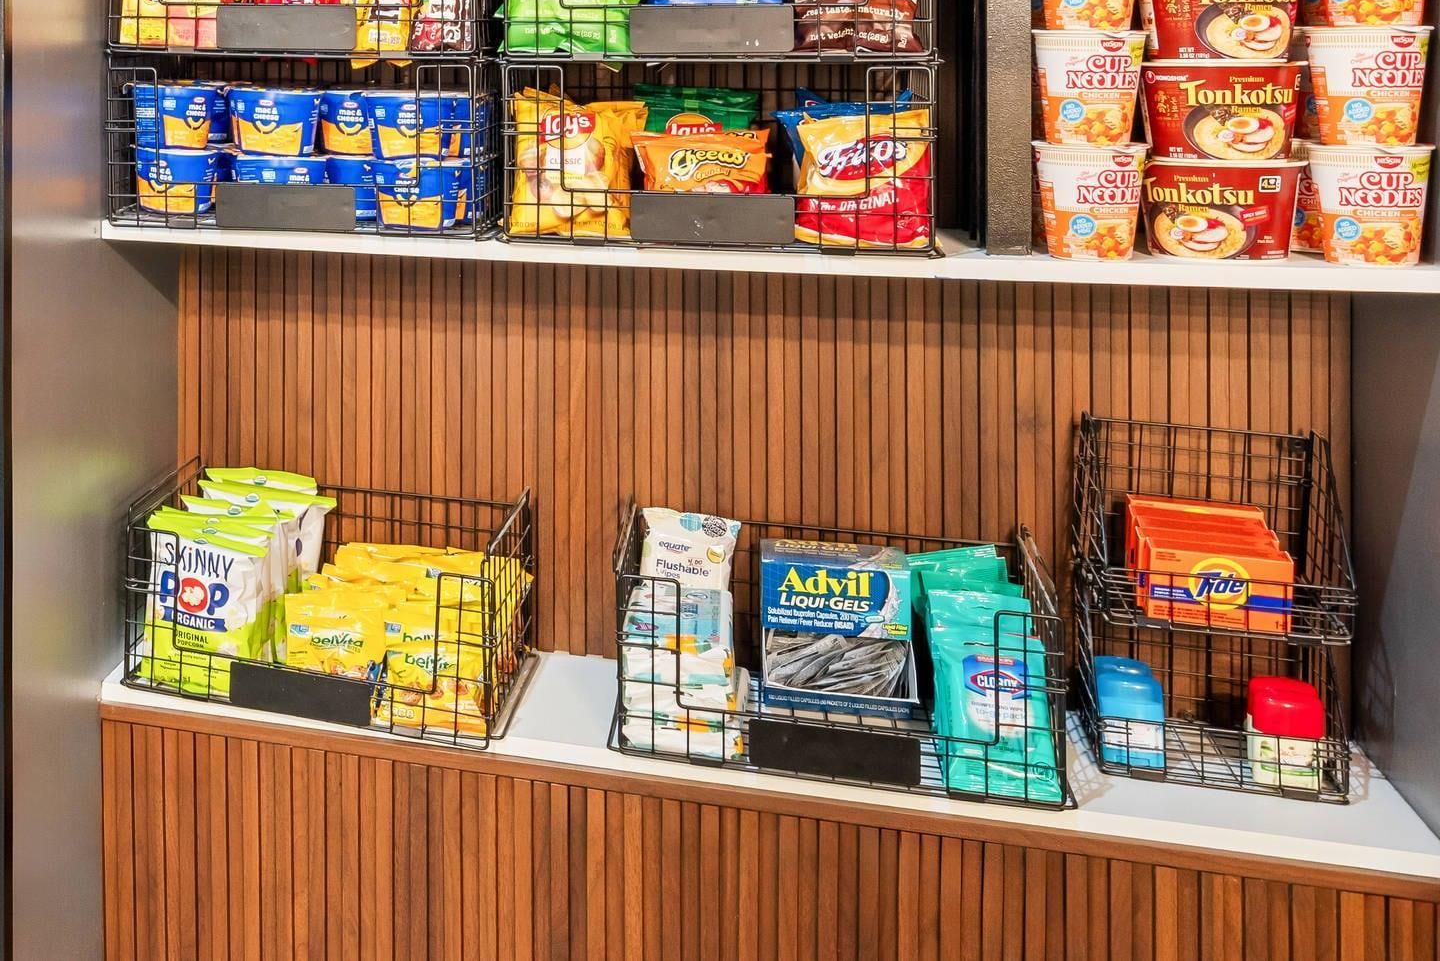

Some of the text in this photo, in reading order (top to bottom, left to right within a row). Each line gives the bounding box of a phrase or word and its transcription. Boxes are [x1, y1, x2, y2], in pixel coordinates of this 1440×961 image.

[1244, 3, 1273, 12] Ramen
[1086, 55, 1132, 73] CUP
[1375, 51, 1423, 70] CUP
[1066, 70, 1138, 89] NOODLES
[1179, 79, 1293, 106] Tonkotsu
[1231, 105, 1261, 114] Ramen
[337, 115, 364, 123] cheese
[544, 114, 592, 139] Lay's
[670, 149, 748, 175] Cheetos
[818, 139, 908, 178] Fritos
[150, 166, 165, 174] mac
[694, 167, 731, 182] Crunchy
[1098, 170, 1140, 188] CUP
[1173, 175, 1209, 183] Premium
[1359, 171, 1414, 190] CUP
[1143, 177, 1255, 205] Tonkotsu
[1339, 187, 1423, 207] NOODLES
[820, 201, 836, 211] The
[1177, 205, 1209, 214] Ramen
[1356, 209, 1400, 217] CHICKEN
[659, 540, 690, 552] equate
[164, 542, 235, 582] SKINNY
[655, 558, 710, 577] Flushable
[777, 566, 872, 598] Advil
[1195, 570, 1246, 598] Tide
[160, 569, 230, 616] POP
[767, 606, 793, 616] Solubilized
[793, 608, 816, 618] Ibuprofen
[849, 615, 859, 623] mg
[767, 615, 779, 623] Pain
[813, 618, 833, 628] Reducer
[176, 631, 209, 644] ORIGINAL
[177, 640, 205, 649] POPCORN
[310, 633, 364, 648] belVita
[404, 652, 457, 671] belVita
